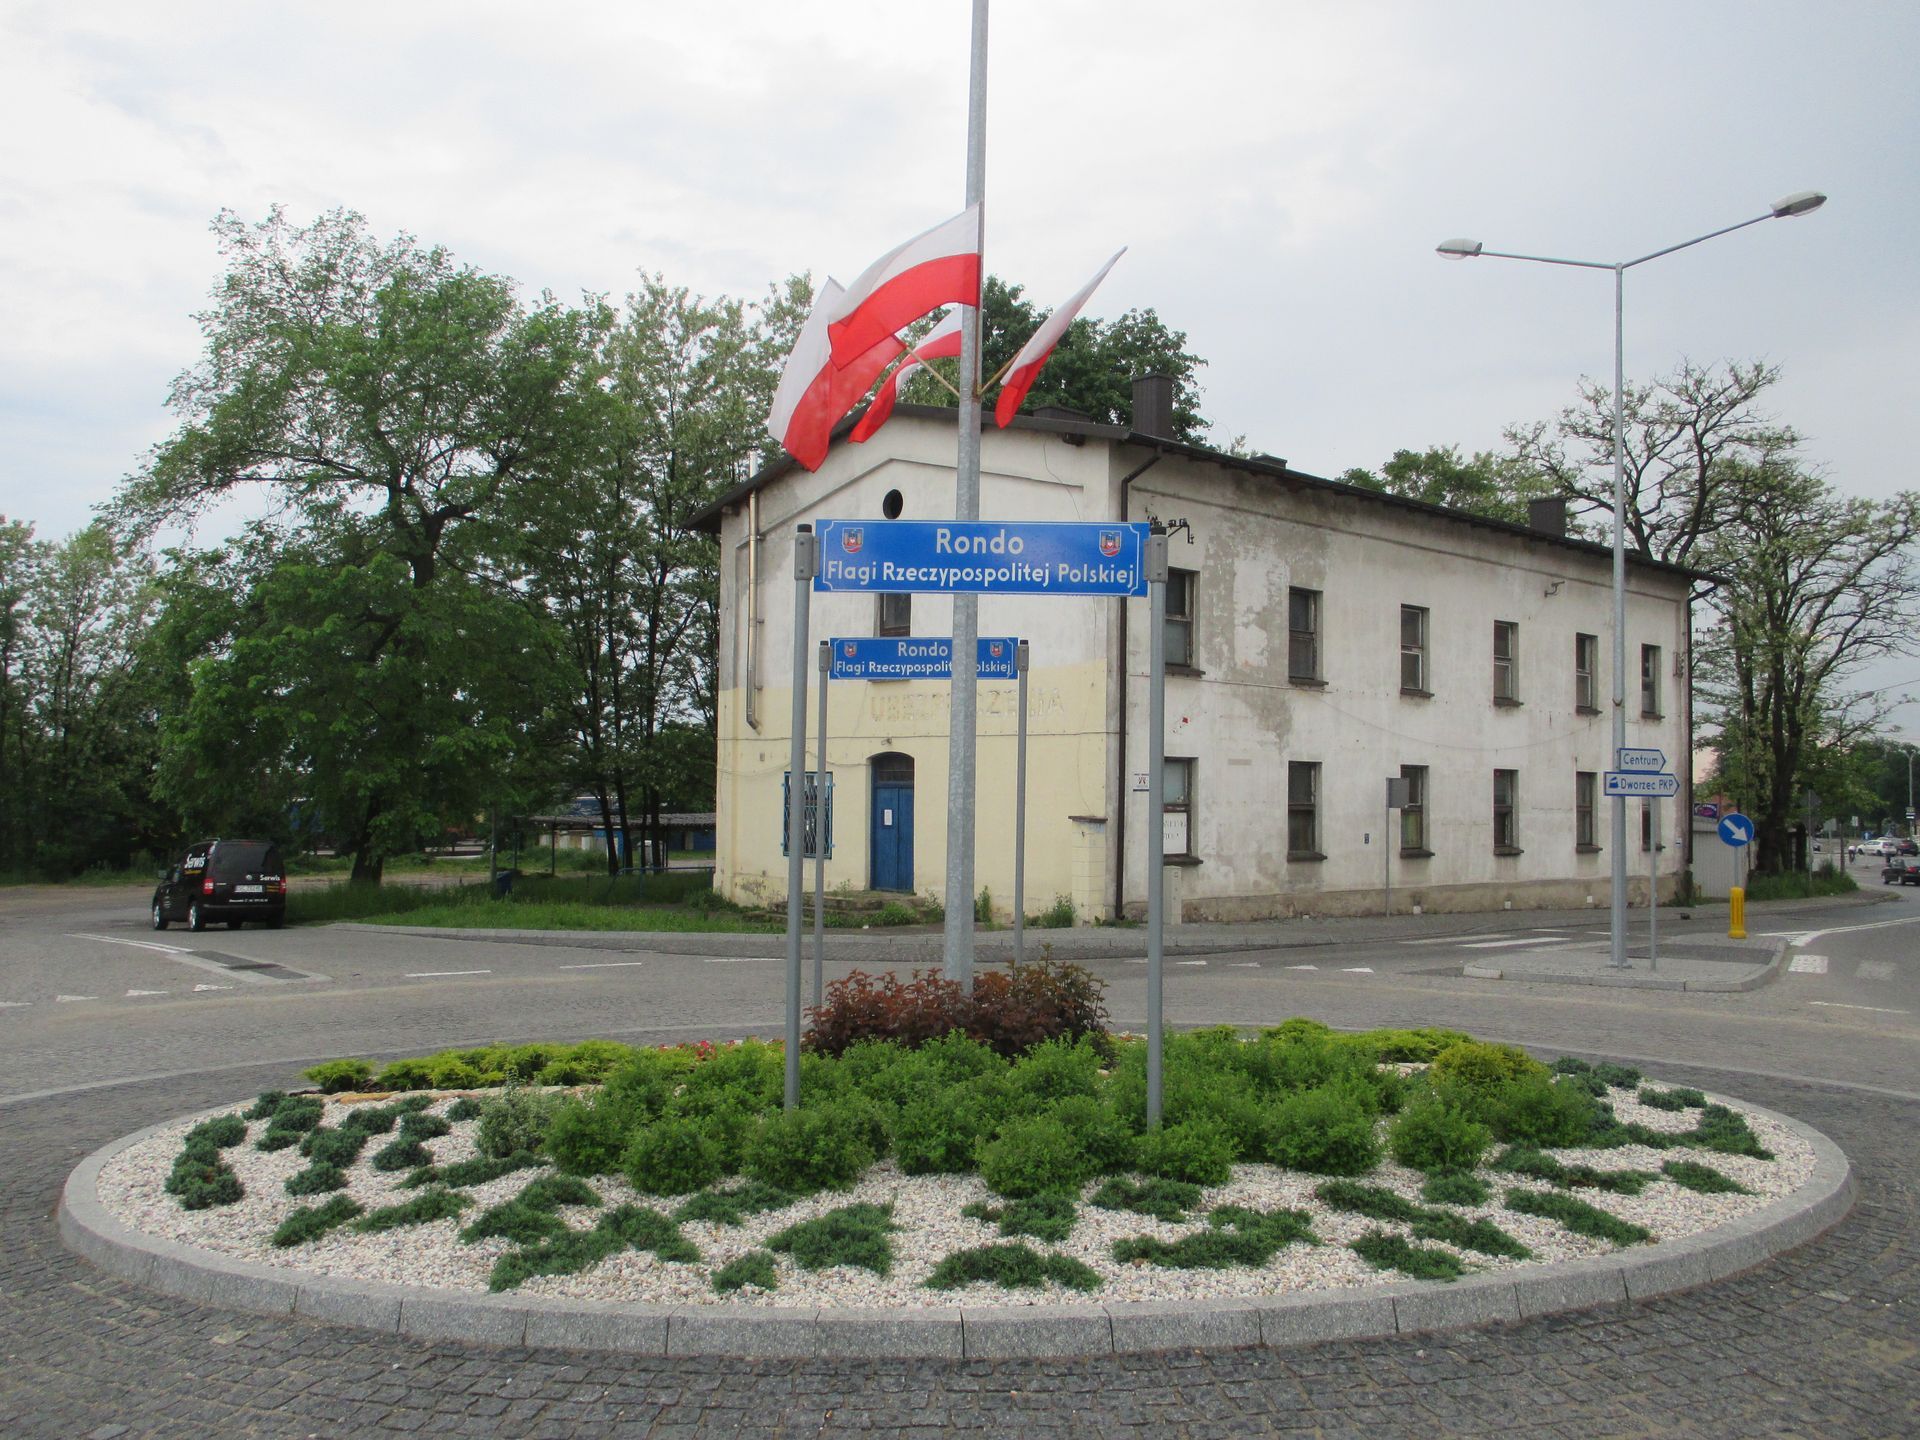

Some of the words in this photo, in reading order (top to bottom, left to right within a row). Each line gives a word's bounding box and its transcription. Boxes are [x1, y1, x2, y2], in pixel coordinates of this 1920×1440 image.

[936, 528, 1024, 555] Rondo
[827, 560, 877, 586] Flagi
[883, 562, 1049, 587] Rzeczypospolitej
[1058, 563, 1134, 589] Polskiej
[898, 641, 949, 657] Rondo
[836, 660, 865, 677] Flagi
[869, 661, 953, 677] Rzeczypospolit
[976, 660, 1010, 677] olskiej
[1623, 752, 1659, 766] Centrum
[1621, 777, 1656, 790] Dworzec
[1659, 779, 1674, 791] PKP
[184, 852, 206, 868] Serwis
